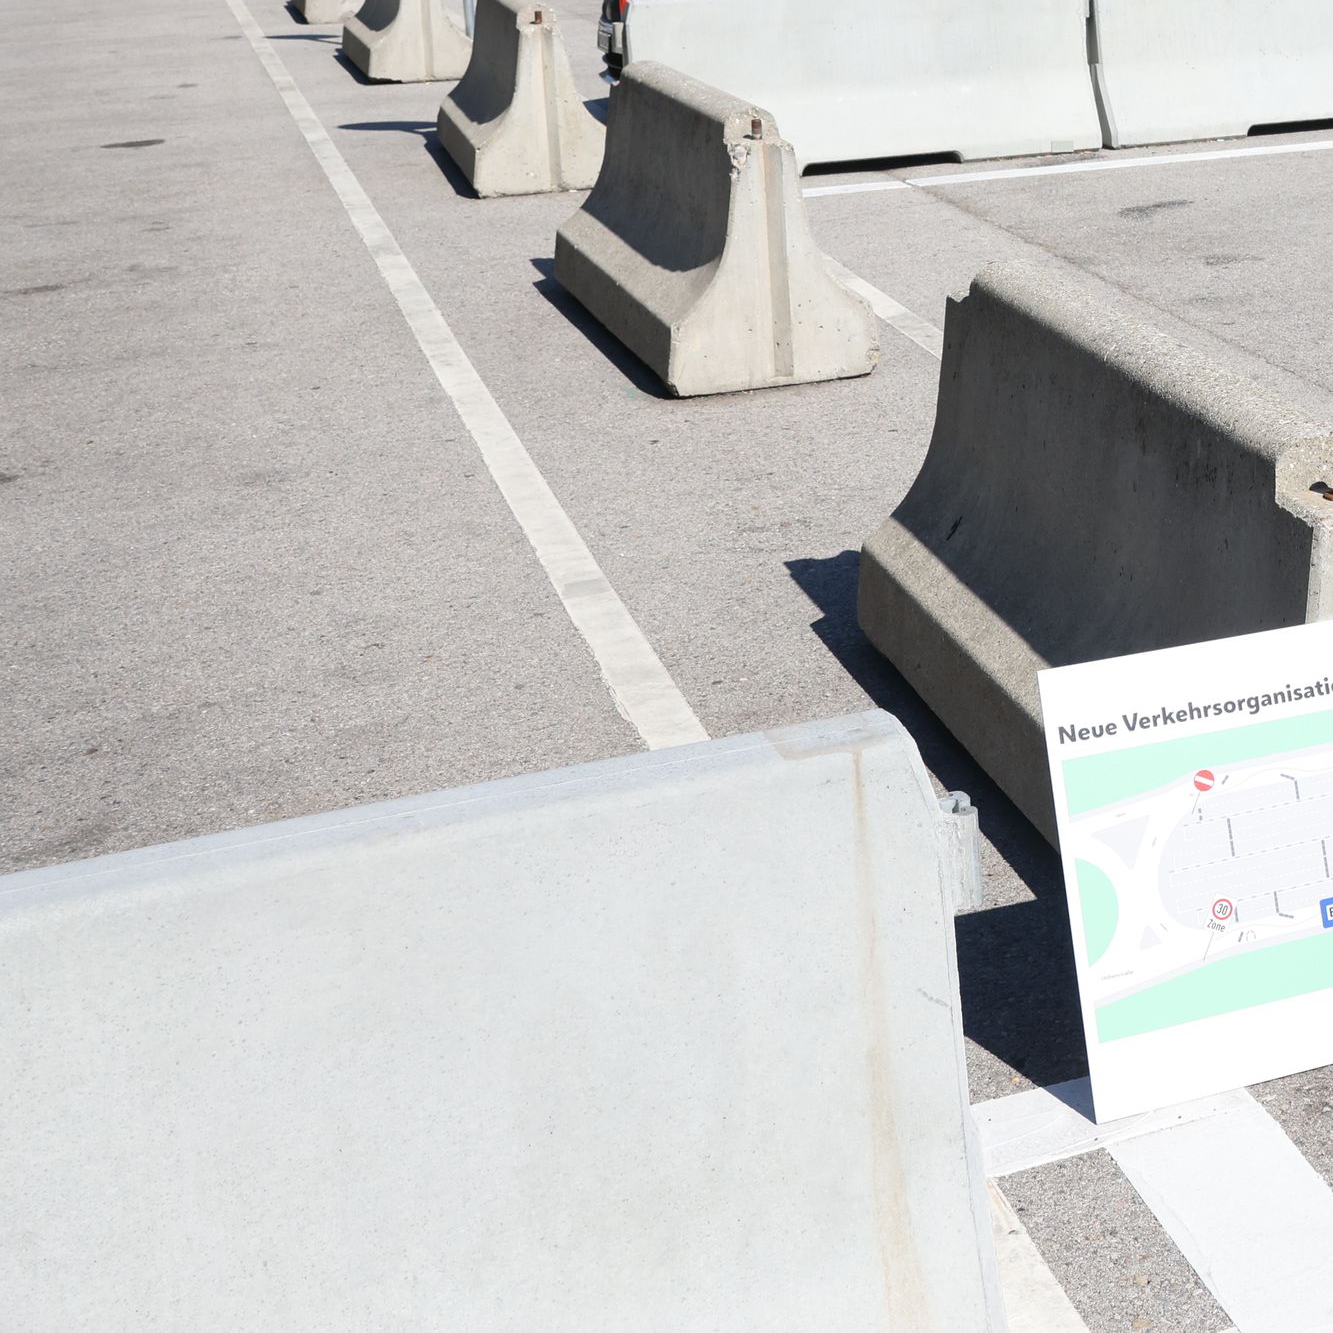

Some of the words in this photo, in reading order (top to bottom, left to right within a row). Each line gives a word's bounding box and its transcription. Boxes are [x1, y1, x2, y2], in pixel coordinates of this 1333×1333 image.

[1058, 722, 1118, 744] Neue
[1216, 903, 1229, 916] 30
[1206, 918, 1226, 933] Zone
